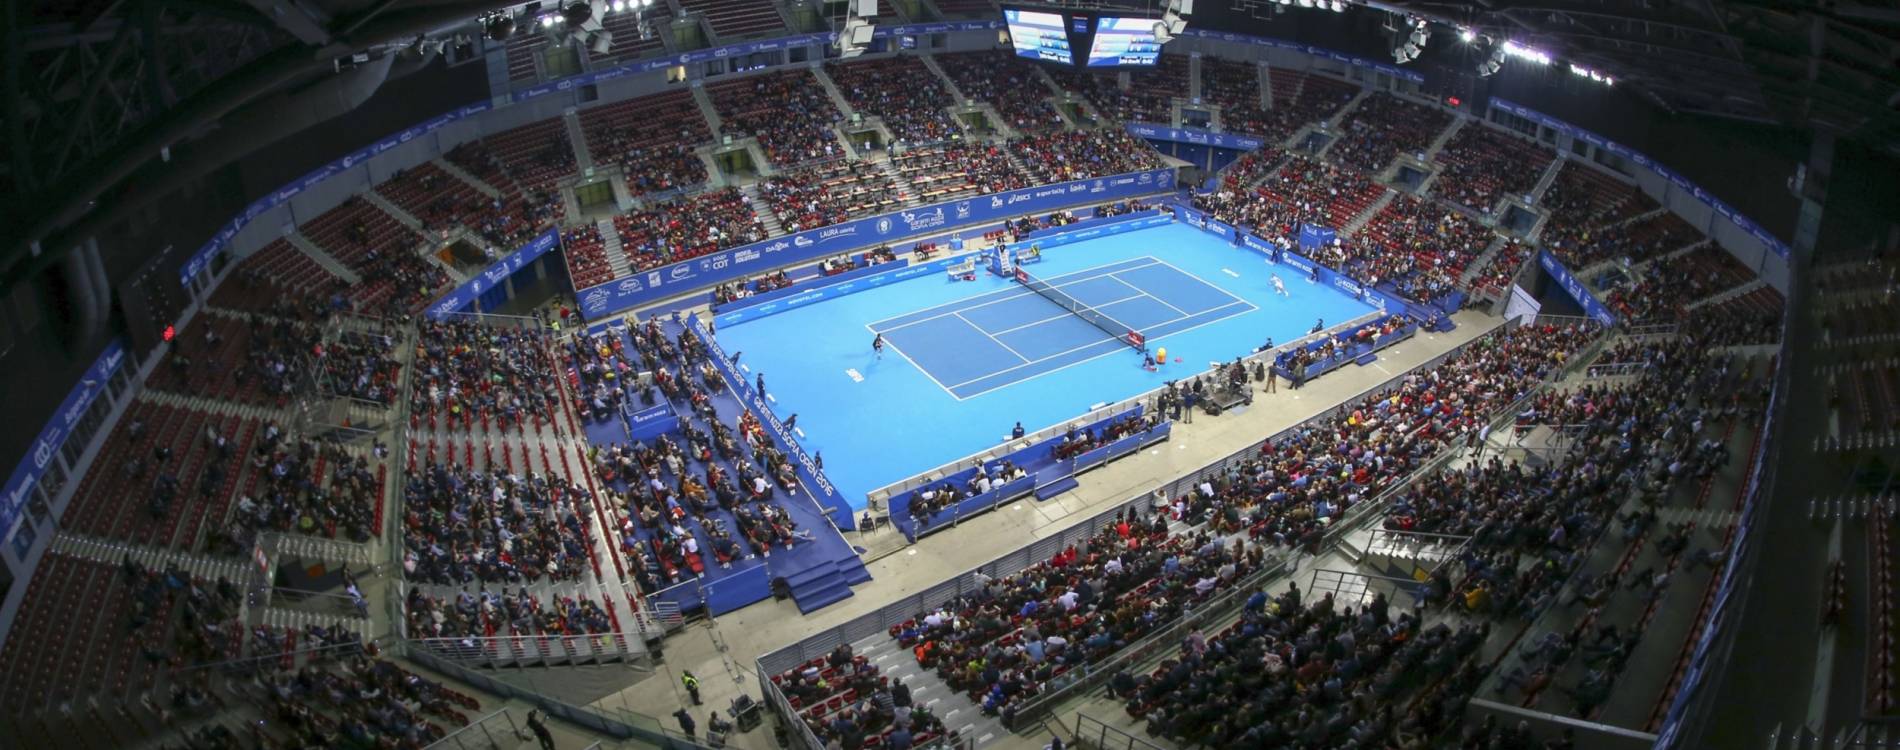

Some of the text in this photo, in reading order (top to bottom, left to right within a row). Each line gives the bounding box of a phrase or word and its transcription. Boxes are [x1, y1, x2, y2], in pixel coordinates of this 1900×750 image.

[820, 228, 838, 239] LAURA
[781, 431, 800, 457] SOFIA
[800, 453, 817, 478] OPEN
[816, 475, 834, 497] 2016
